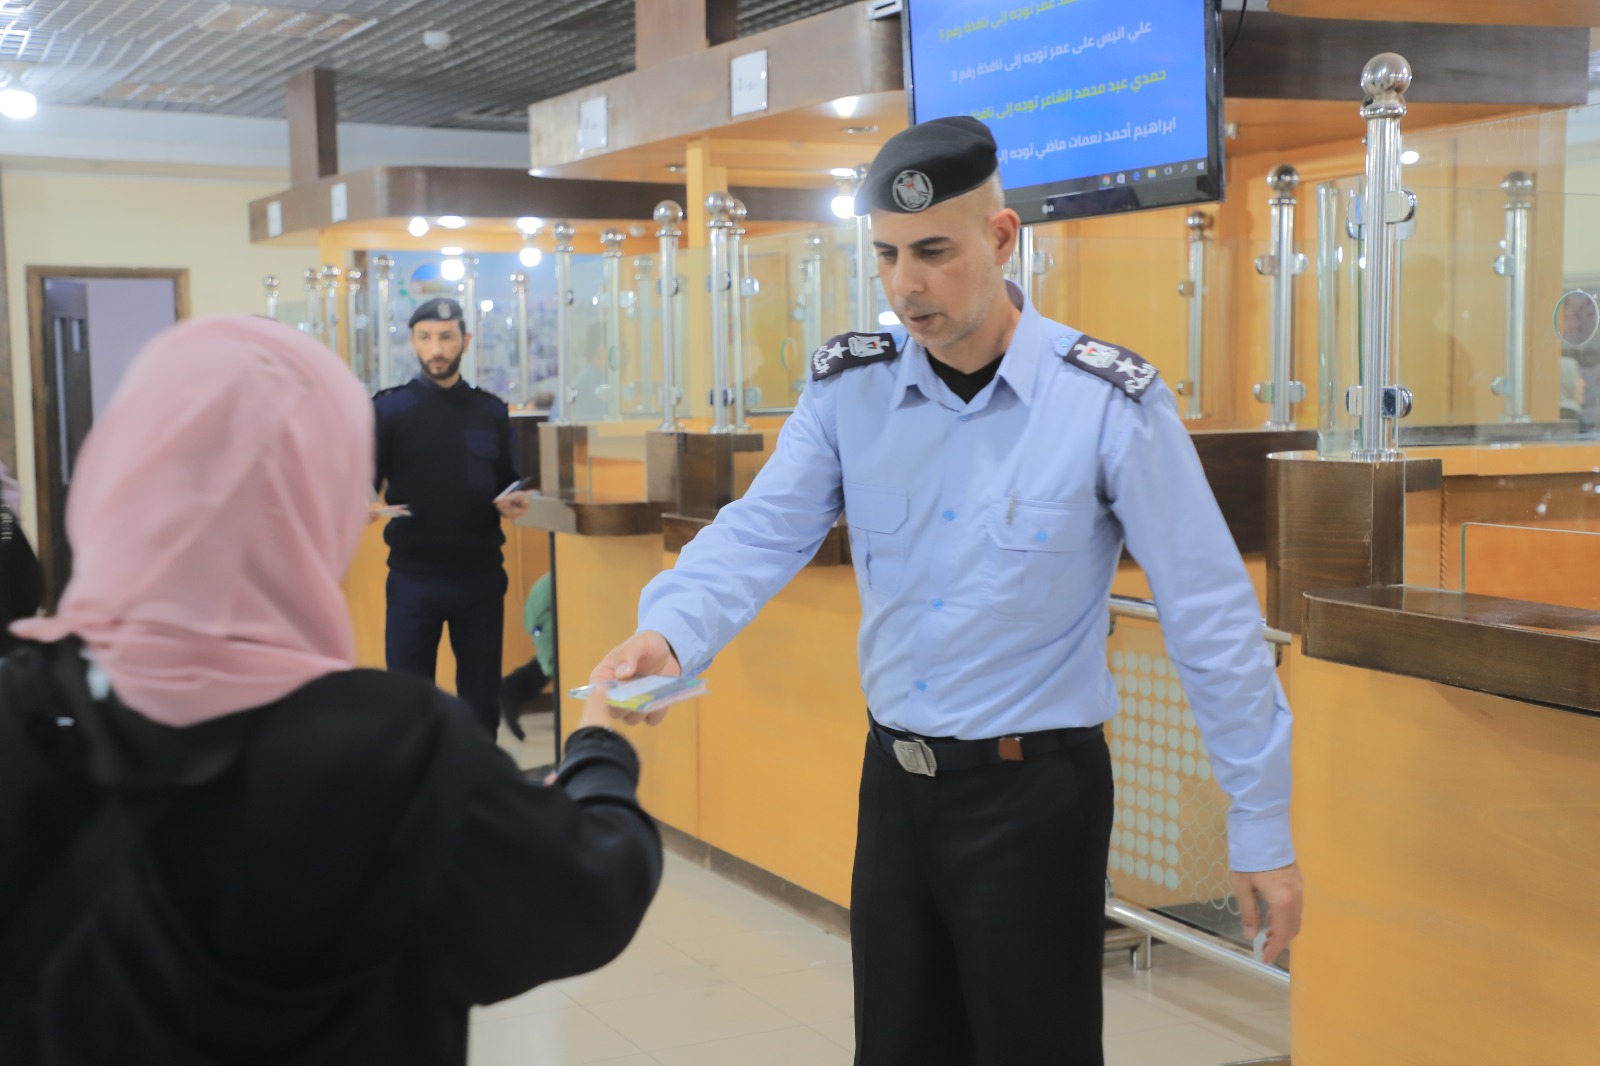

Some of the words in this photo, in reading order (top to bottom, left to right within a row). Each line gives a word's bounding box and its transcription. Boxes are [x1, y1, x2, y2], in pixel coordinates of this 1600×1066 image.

[990, 11, 1008, 28] إلى
[1009, 2, 1034, 20] توجه
[945, 24, 963, 42] رقم
[963, 16, 989, 33] نافذة
[1127, 21, 1152, 43] علي
[1096, 26, 1125, 48] انيس
[1023, 45, 1048, 64] توجه
[1050, 43, 1070, 61] عمر
[977, 58, 1003, 75] نافذة
[1004, 53, 1021, 72] إلى
[951, 70, 957, 82] 3
[958, 65, 976, 84] رقم
[1130, 70, 1167, 93] حمدي
[1074, 84, 1106, 99] محمد
[1108, 78, 1128, 93] عبد
[1014, 95, 1039, 114] توجه
[1040, 88, 1073, 110] الشاعر
[995, 102, 1013, 120] إلى
[1104, 121, 1131, 143] أحمد
[1133, 116, 1176, 141] ابراهيم
[1068, 130, 1102, 149] نعمات
[1009, 143, 1034, 161] توجه
[1035, 138, 1066, 161] ماضي
